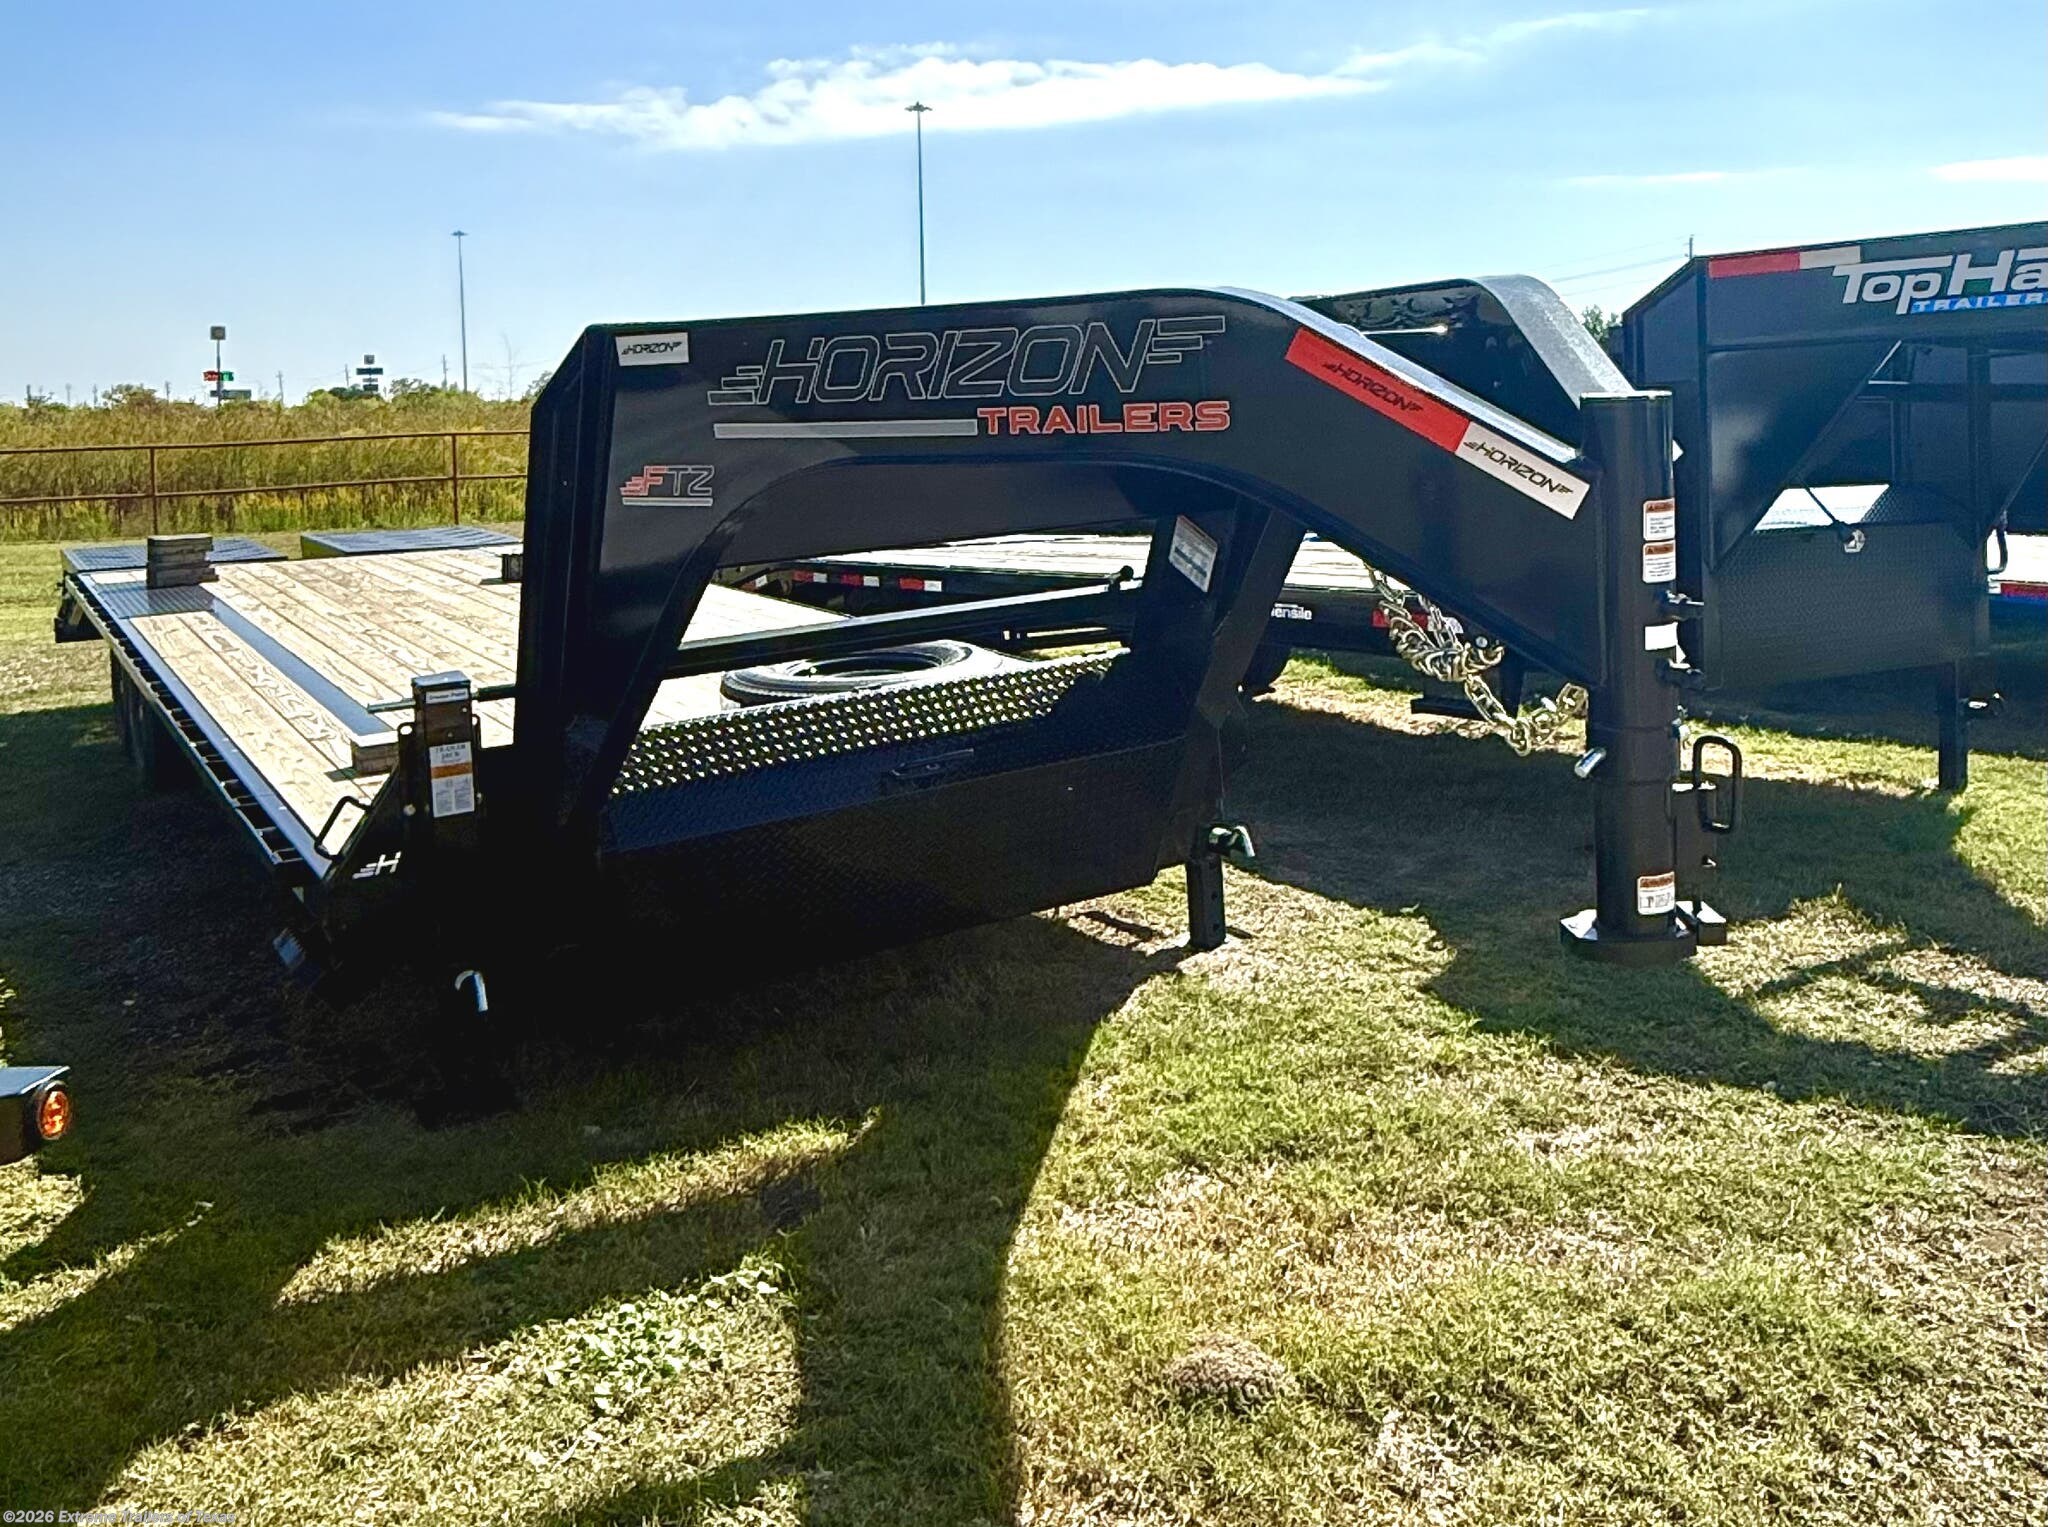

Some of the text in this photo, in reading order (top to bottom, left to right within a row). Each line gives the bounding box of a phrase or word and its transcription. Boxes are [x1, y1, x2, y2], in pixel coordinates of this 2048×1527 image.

[1911, 291, 2048, 314] TRAILER
[627, 342, 675, 355] HORIZON
[757, 318, 1156, 405] HORIZON
[1330, 362, 1414, 411] HORIZON
[977, 401, 1231, 435] TRAILERS
[1474, 441, 1562, 494] HORIZON
